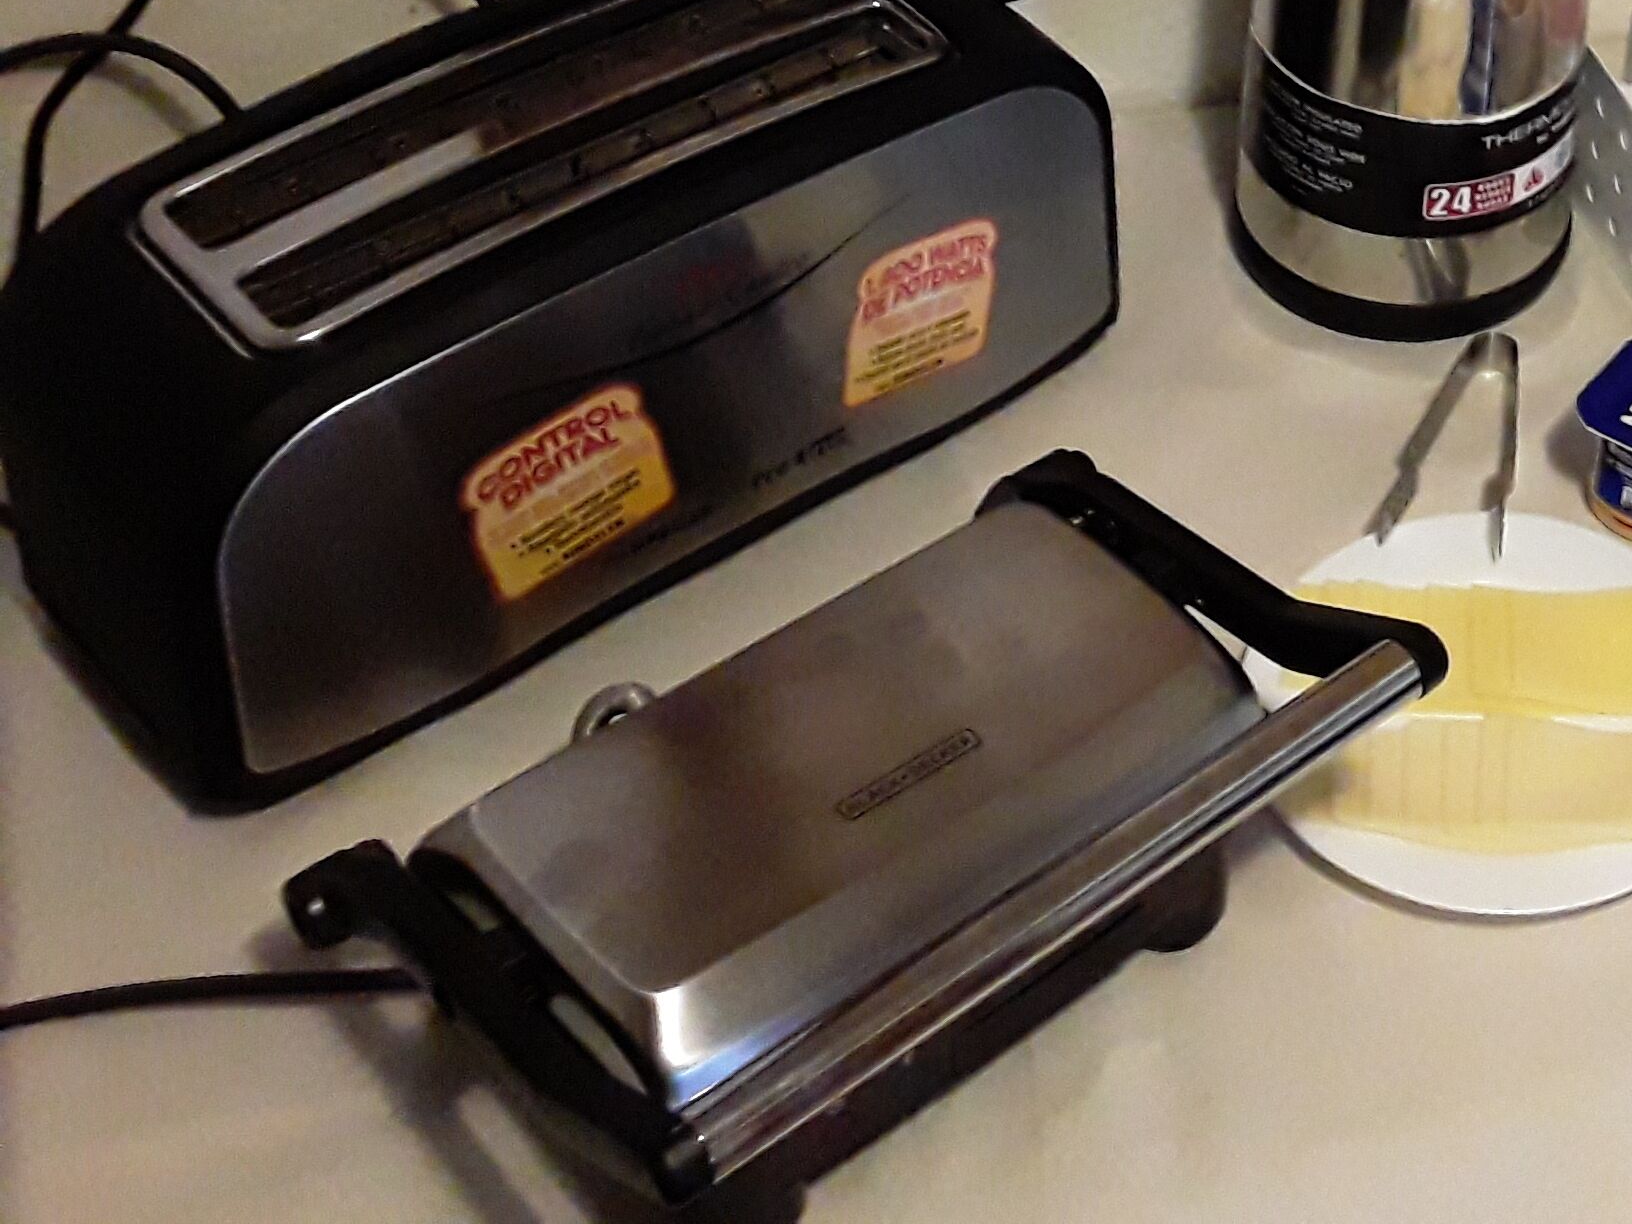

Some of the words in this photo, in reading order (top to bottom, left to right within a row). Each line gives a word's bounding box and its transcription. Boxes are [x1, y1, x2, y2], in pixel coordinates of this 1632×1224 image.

[1429, 186, 1473, 217] 24
[477, 398, 632, 503] CONTROL
[500, 426, 621, 509] DIGITAL
